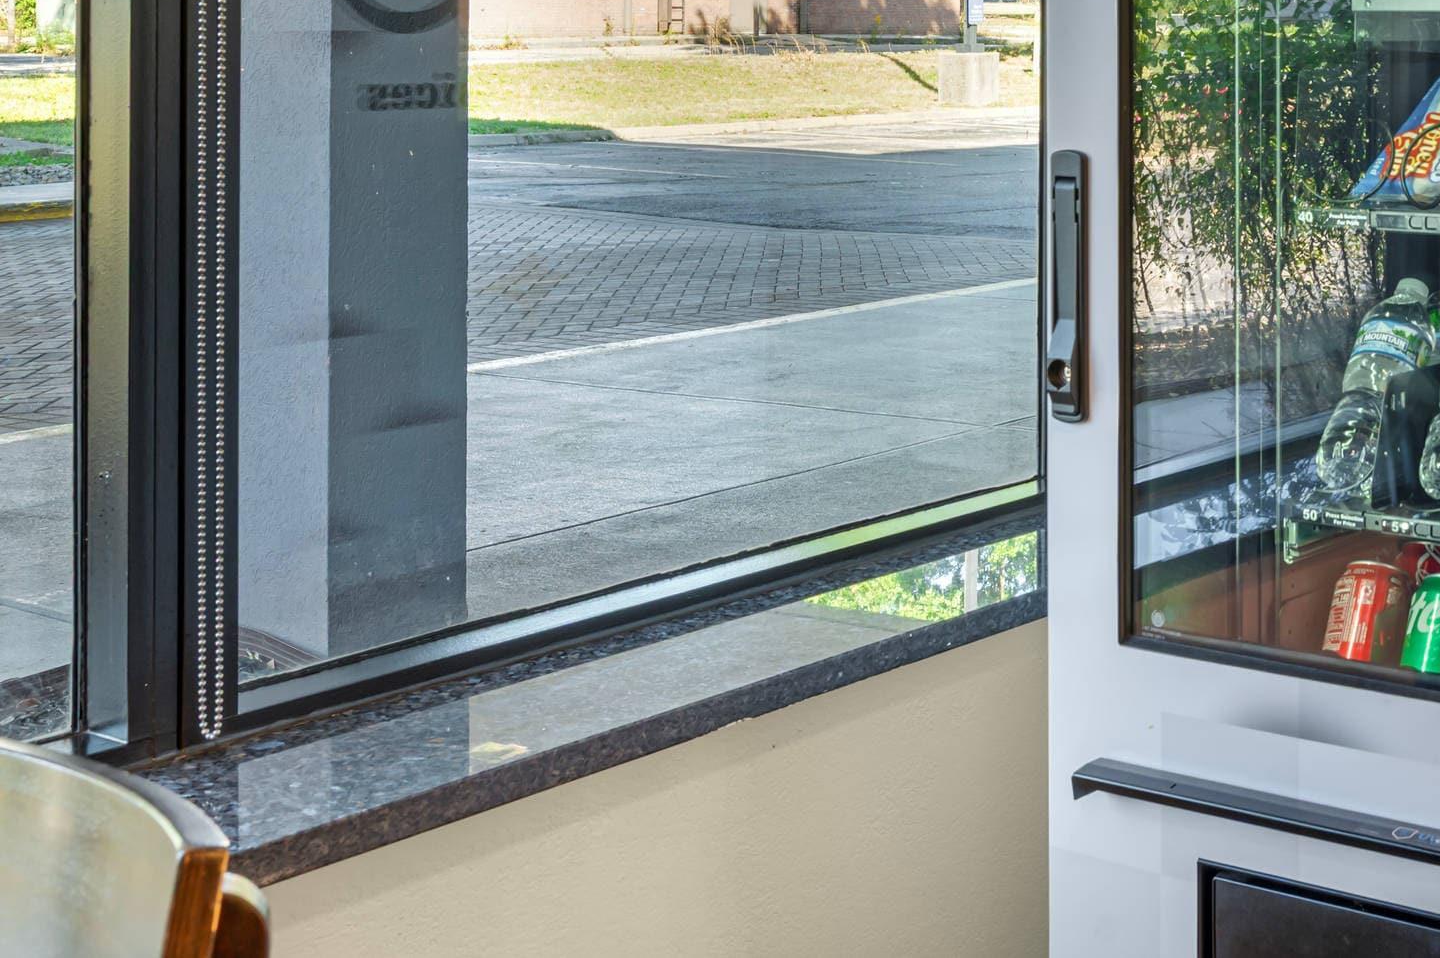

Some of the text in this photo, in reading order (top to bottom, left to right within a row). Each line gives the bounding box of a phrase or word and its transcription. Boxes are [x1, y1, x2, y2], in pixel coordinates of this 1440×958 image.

[1297, 212, 1313, 223] 40
[1364, 332, 1407, 350] MOUNTAIN
[1303, 509, 1318, 521] 50
